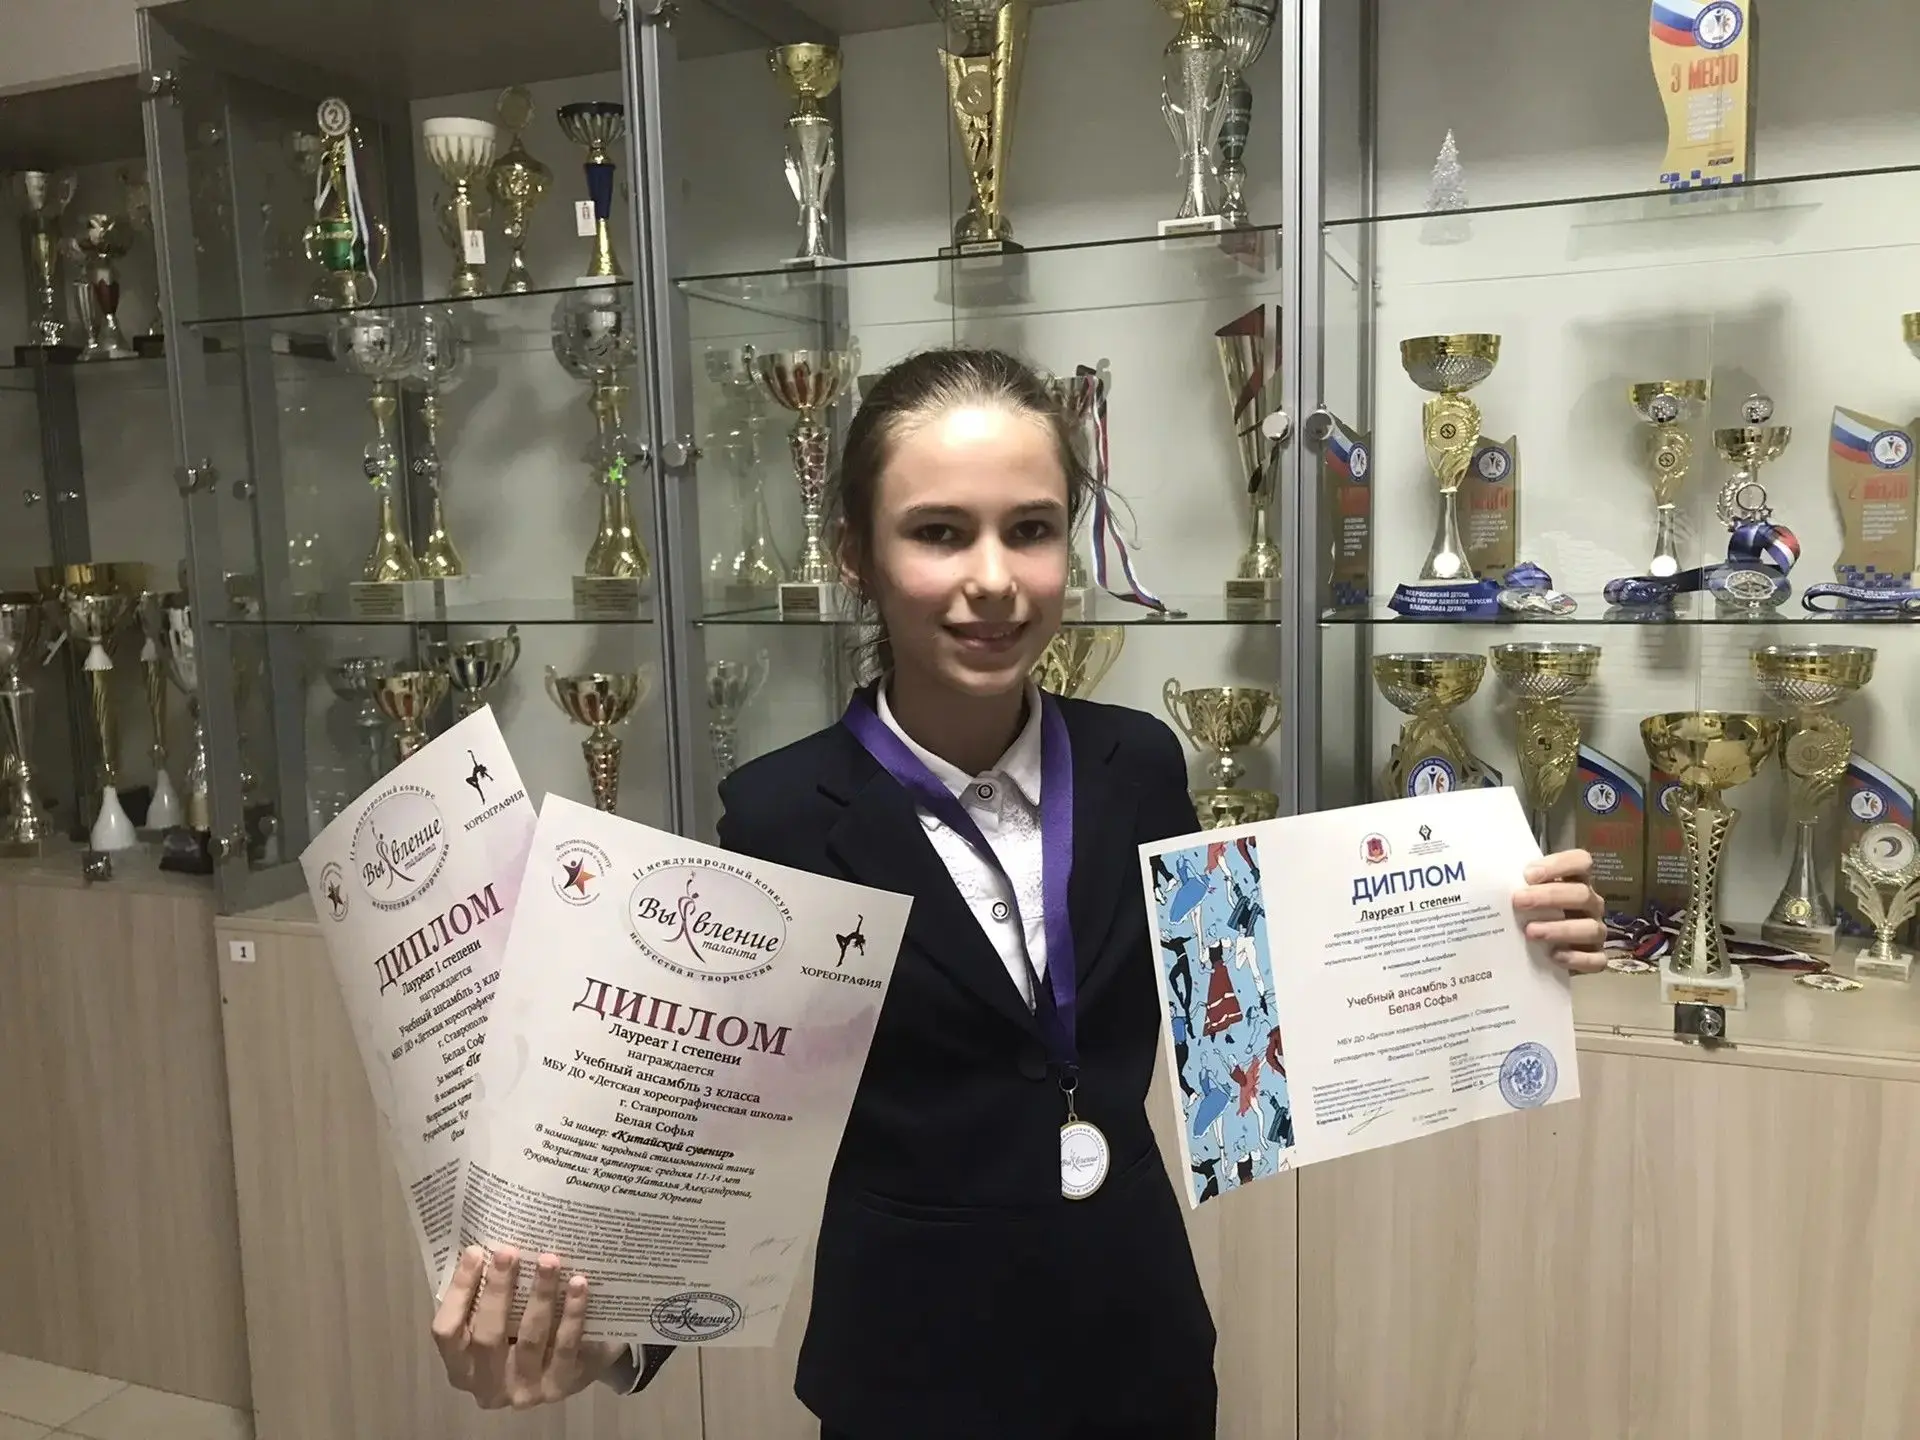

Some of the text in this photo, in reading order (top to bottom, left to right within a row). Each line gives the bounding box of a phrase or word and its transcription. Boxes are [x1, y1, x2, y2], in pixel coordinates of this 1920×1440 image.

[1670, 53, 1739, 93] 3 МЕСТО
[463, 789, 526, 833] ХОРЕОГРАФИЯ
[647, 856, 753, 880] международный
[754, 878, 793, 923] конкурс
[1351, 861, 1466, 905] ДИПЛОМ
[1360, 904, 1405, 922] Лауреат
[1419, 893, 1462, 910] степени
[240, 946, 247, 958] 1
[373, 882, 505, 996] ДИПЛОМ
[629, 932, 773, 984] искусства и творчества
[701, 939, 758, 961] таланта
[401, 966, 435, 996] Лауреат
[441, 938, 483, 970] степени
[418, 964, 473, 1004] награждается
[799, 965, 884, 990] ХОРЕОГРАФИЯ
[432, 985, 474, 1016] ансамбль
[473, 982, 483, 995] 3
[1346, 969, 1493, 1009] Учебный ансамбль 3 класса
[1387, 991, 1459, 1016] Белая Софья
[443, 1014, 489, 1044] Ставрополь
[572, 976, 793, 1056] ДИПЛОМ
[441, 1046, 468, 1064] Белая
[608, 1022, 742, 1066] Лауреат I степени
[627, 1048, 715, 1077] награждается
[541, 1056, 793, 1121] МБУ ДО «Детская хореографическая школа»
[573, 1049, 761, 1104] Учебный ансамбль 3 класса
[614, 1112, 695, 1138] Белая Софья
[619, 1098, 699, 1122] г. Ставрополь
[534, 1123, 756, 1176] В номинации: народный стилизованный танец
[560, 1116, 573, 1128] За
[575, 1122, 609, 1137] номер:
[610, 1129, 684, 1152] «Китайский
[522, 1147, 753, 1200] Руководители: Конопко Наталья Александровна,
[541, 1140, 741, 1185] Возрастная категория: средняя 11-14 лет
[565, 1175, 703, 1206] Фоменко Светлана Юрьевна
